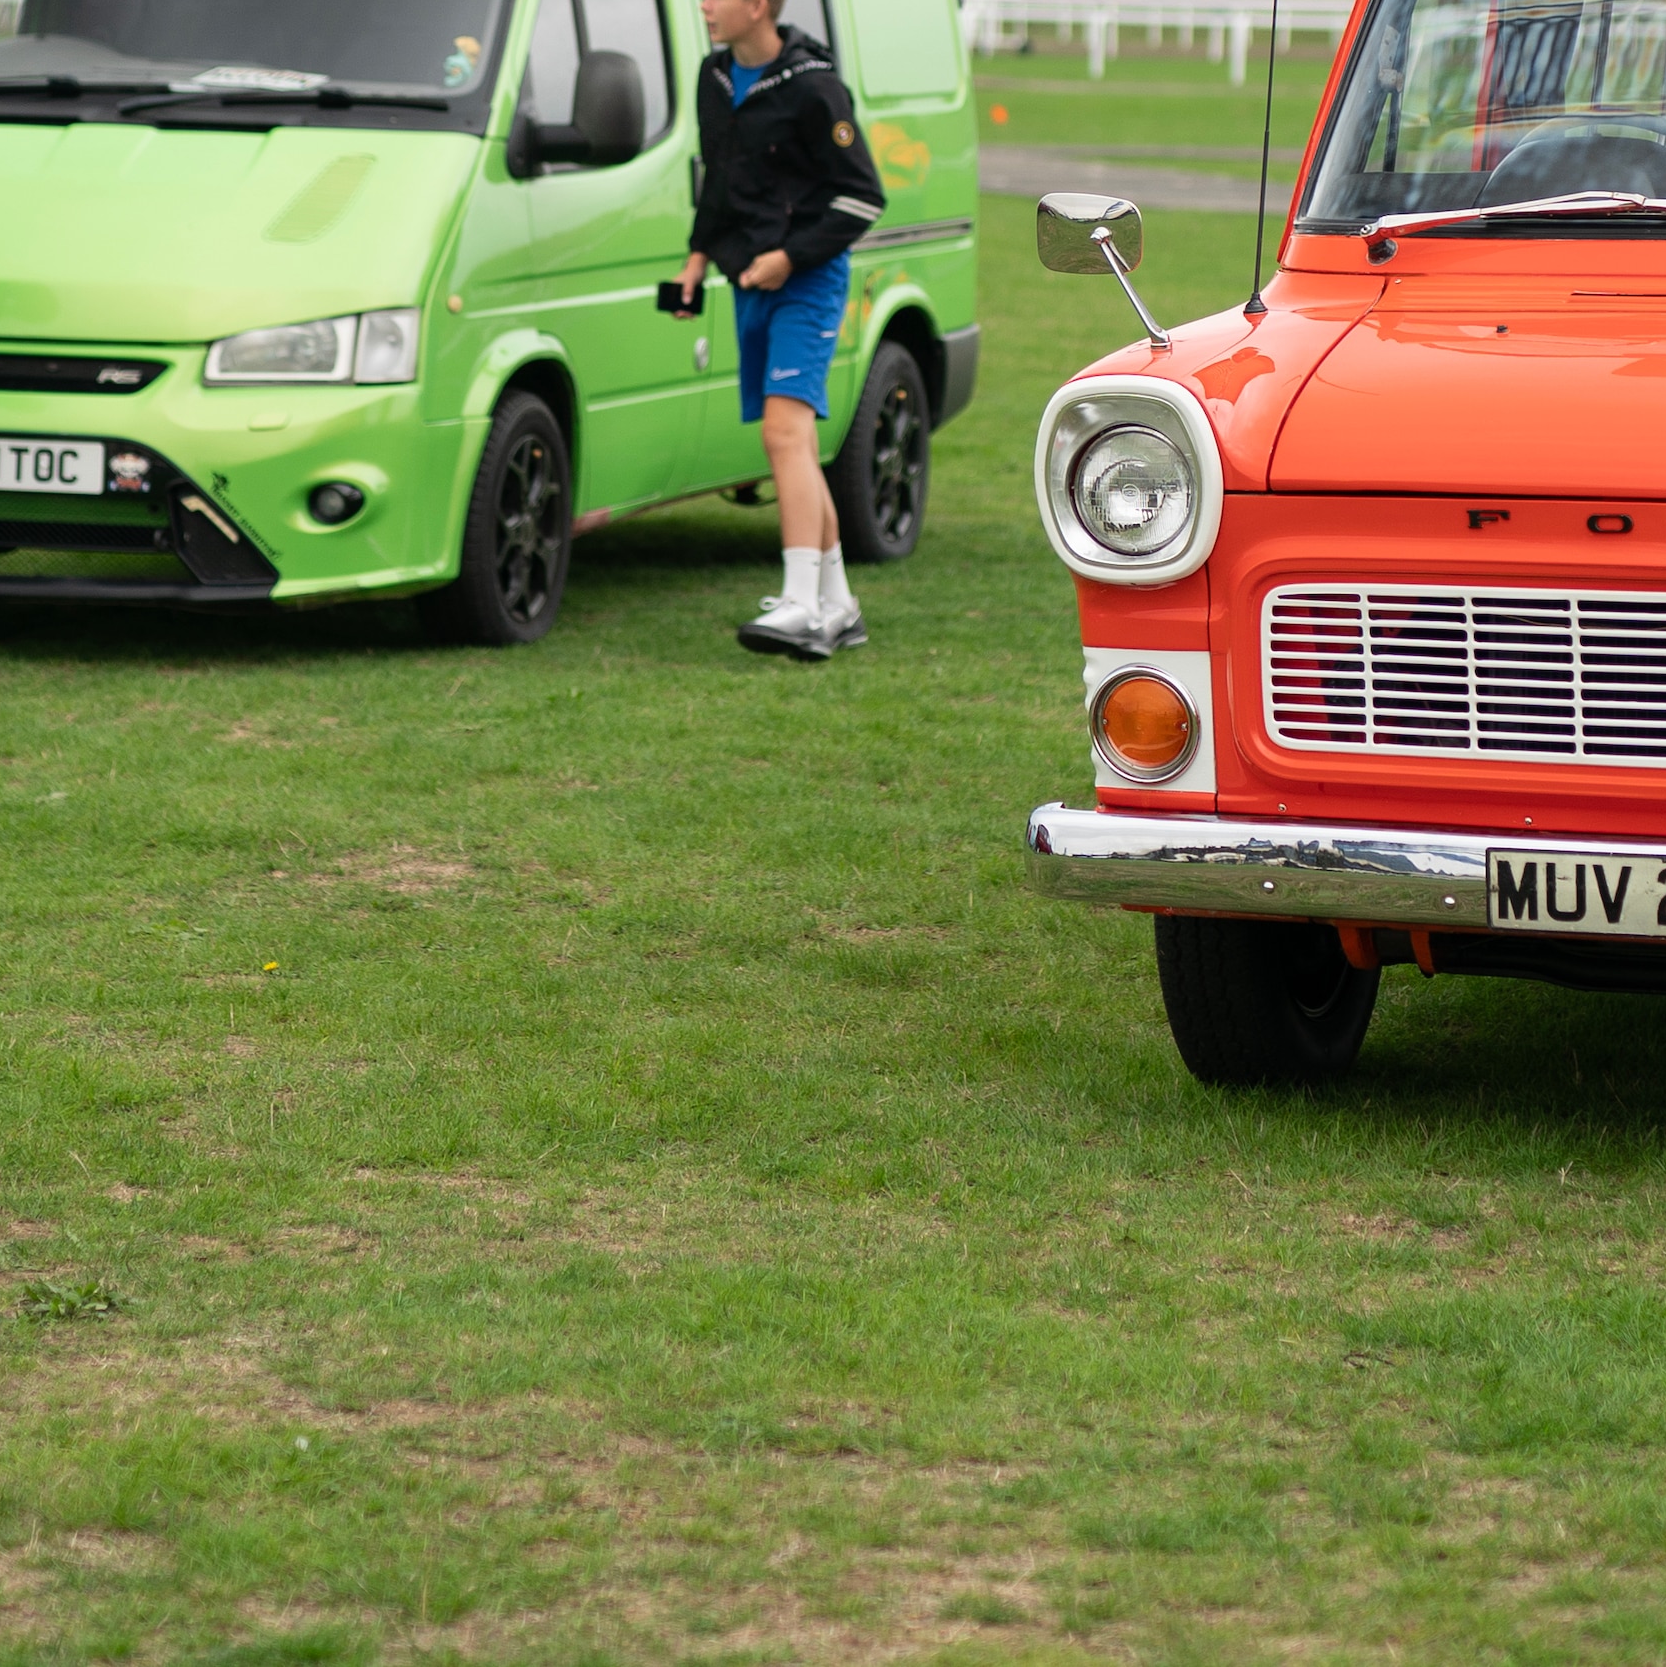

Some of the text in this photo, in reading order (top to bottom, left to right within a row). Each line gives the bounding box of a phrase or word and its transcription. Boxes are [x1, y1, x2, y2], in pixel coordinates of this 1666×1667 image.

[96, 367, 142, 385] RS
[9, 446, 79, 485] TOC
[1497, 860, 1633, 924] MUV
